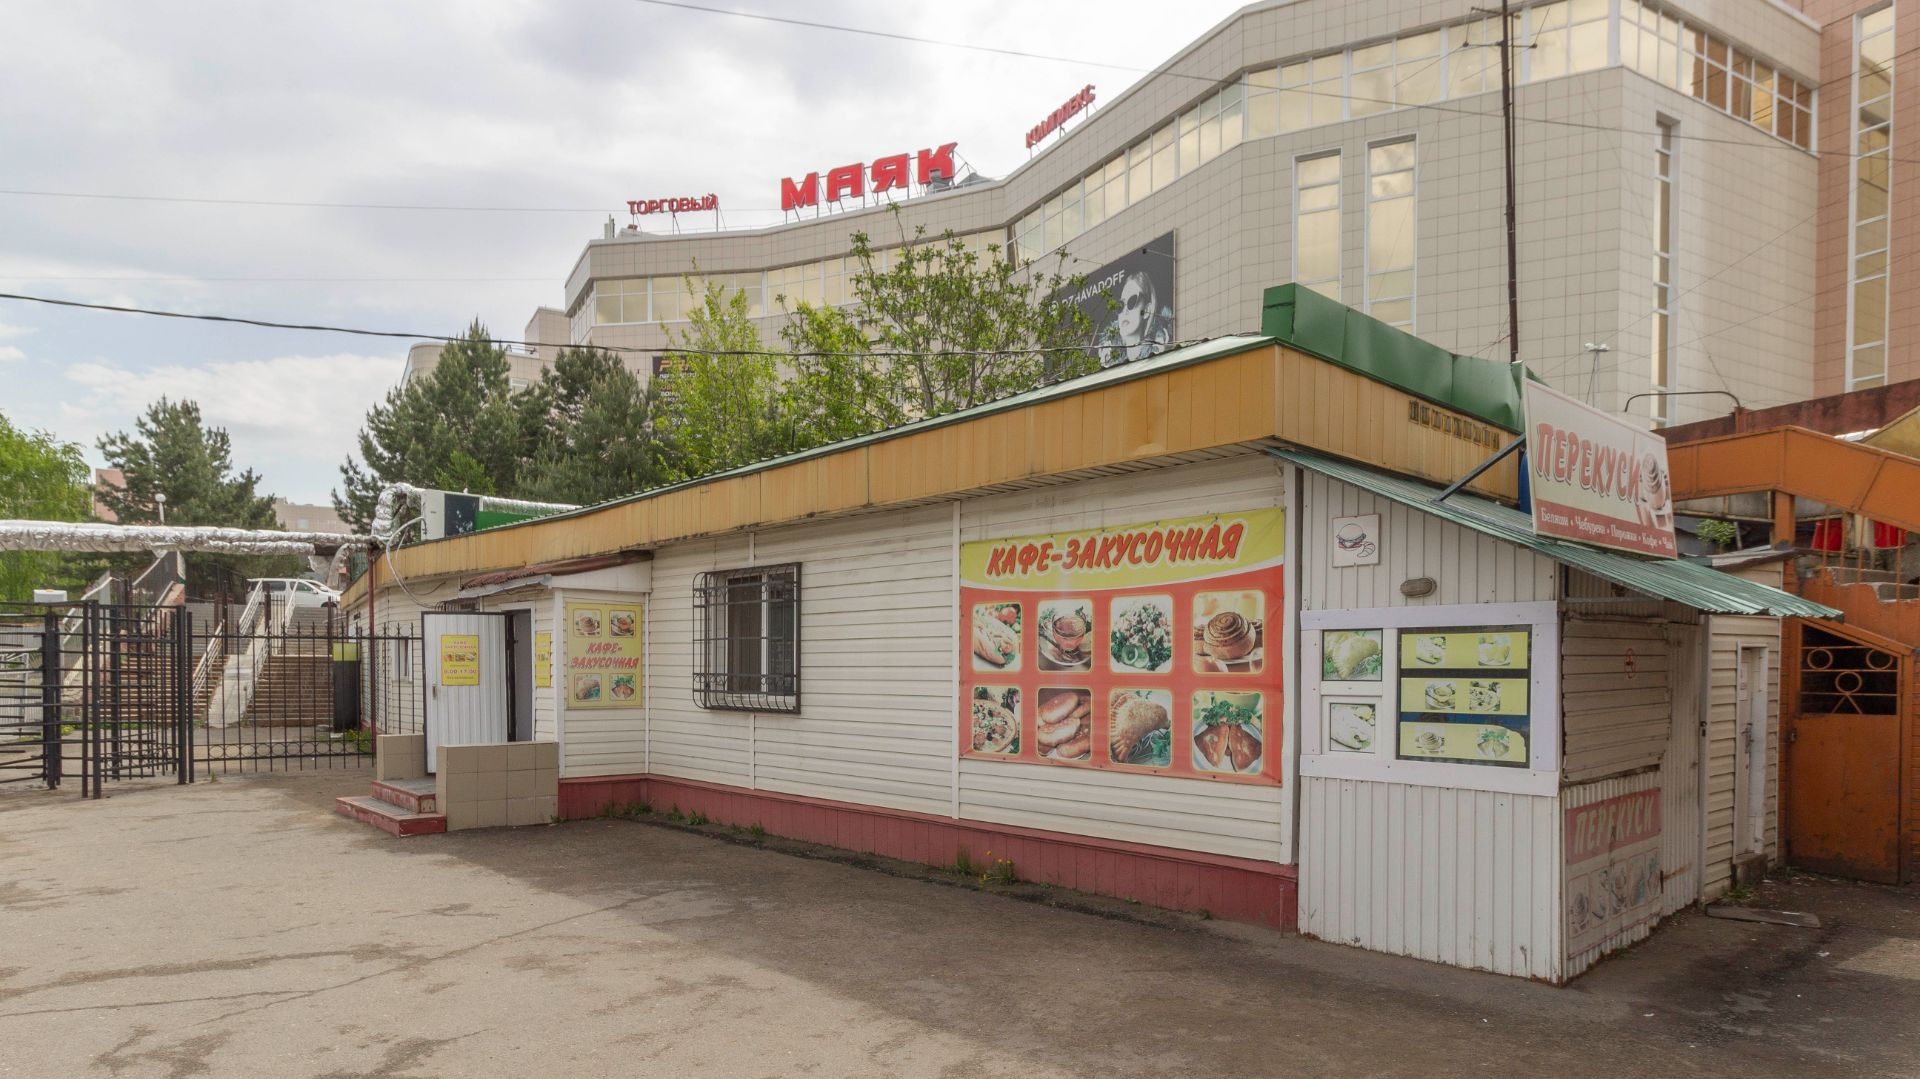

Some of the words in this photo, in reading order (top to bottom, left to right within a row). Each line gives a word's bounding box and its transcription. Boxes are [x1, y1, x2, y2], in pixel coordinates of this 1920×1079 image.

[1025, 84, 1096, 149] КОМПЛЕКС
[627, 192, 718, 215] ТОРГОВЫЙ
[781, 142, 958, 212] МАЯК
[1536, 422, 1642, 507] ПЕРЕКУСИ
[986, 522, 1245, 577] КАФЕ-ЗАКУСОЧНАЯ
[570, 656, 640, 670] ЗАКУСОЧНАЯ
[586, 642, 623, 655] КАФЕ-
[1573, 795, 1655, 855] ПЕРЕКУСИ
